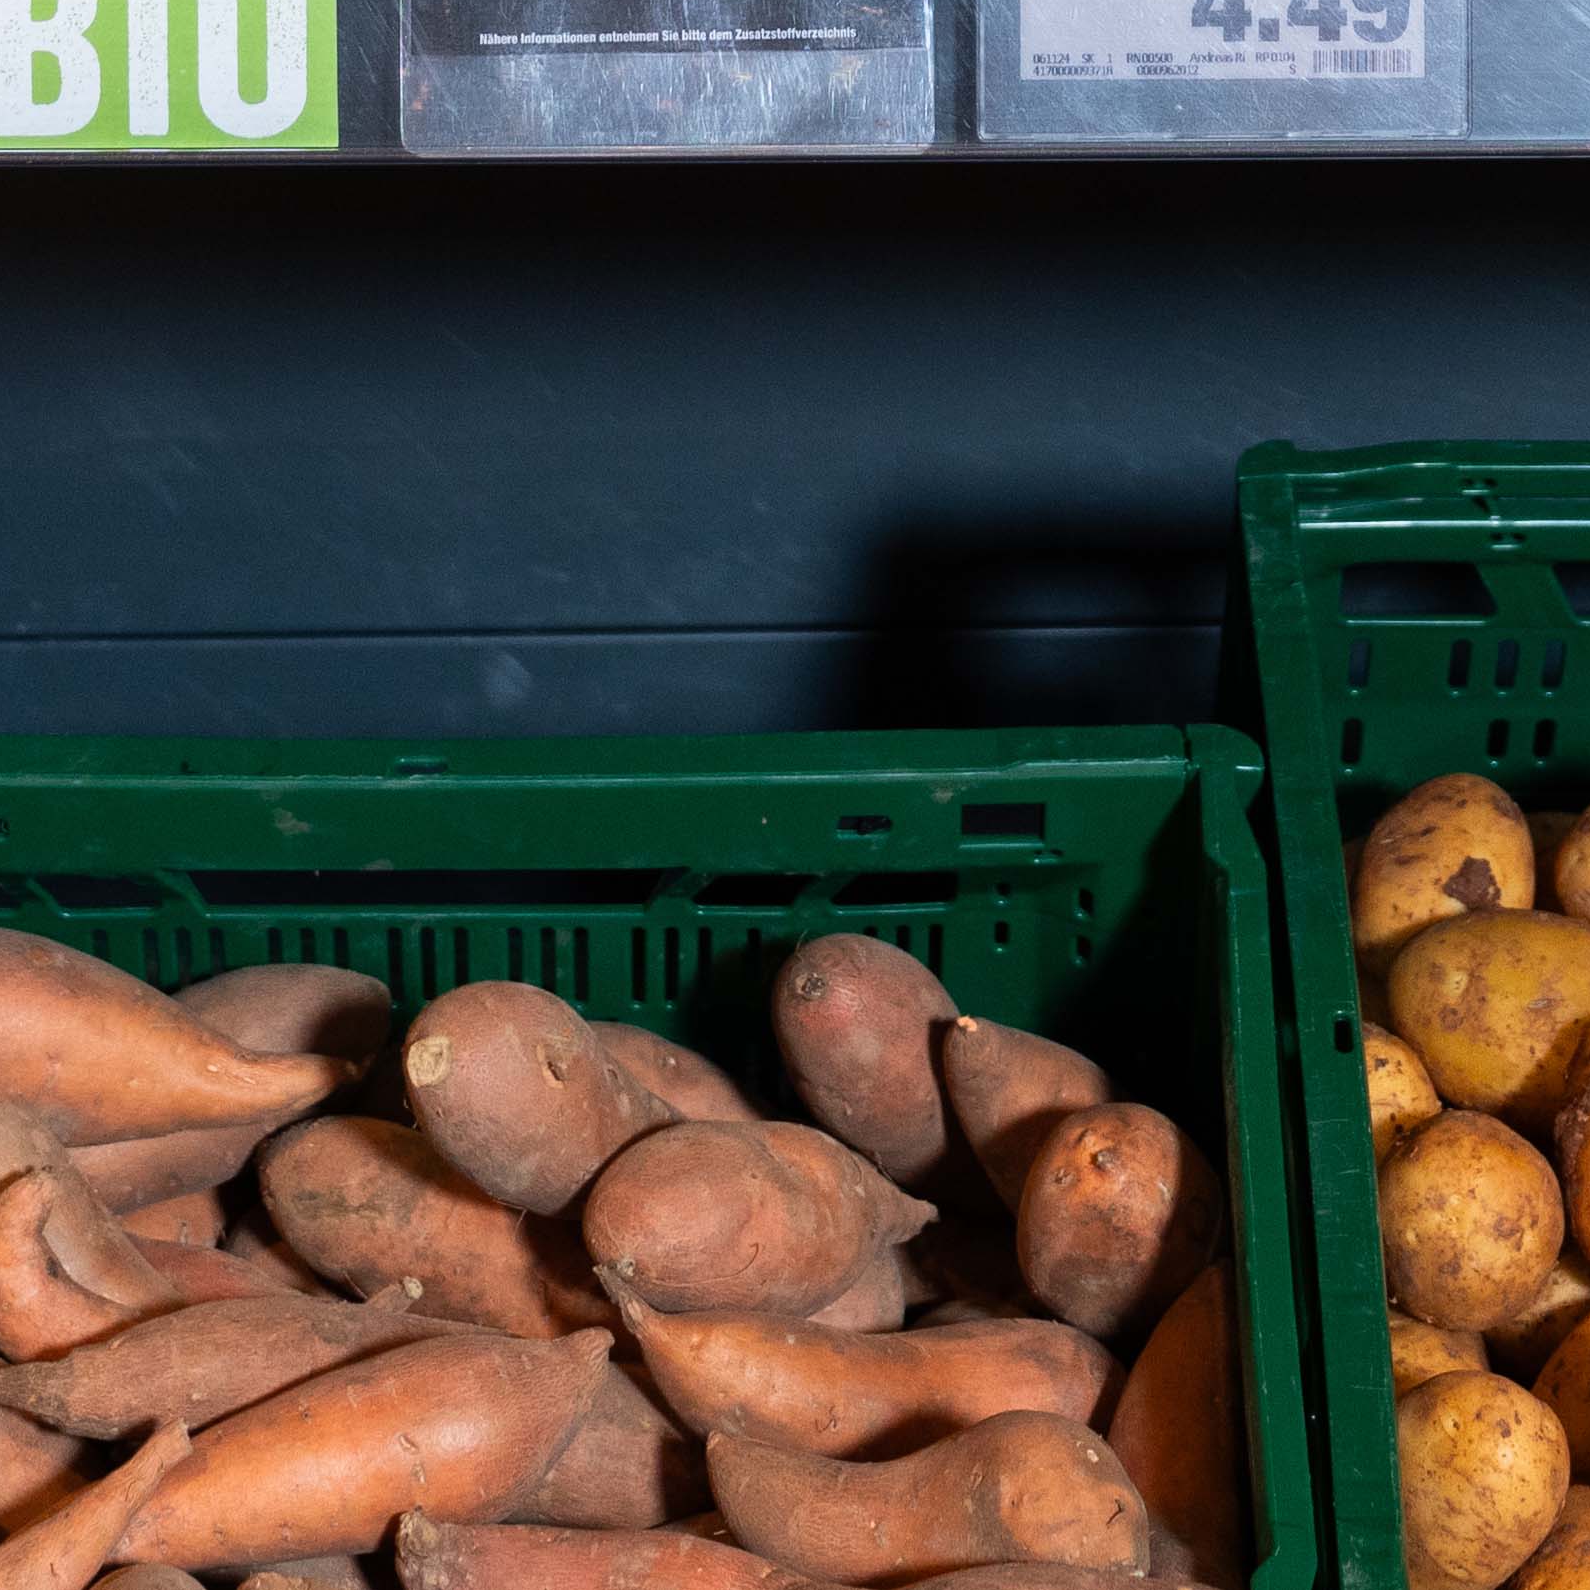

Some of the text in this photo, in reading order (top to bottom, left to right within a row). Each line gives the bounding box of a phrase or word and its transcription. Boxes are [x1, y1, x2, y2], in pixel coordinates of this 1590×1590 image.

[479, 27, 857, 45] Nähere Informationen entnehmen Sie bitte dem Zusatzstoffverzeichnis
